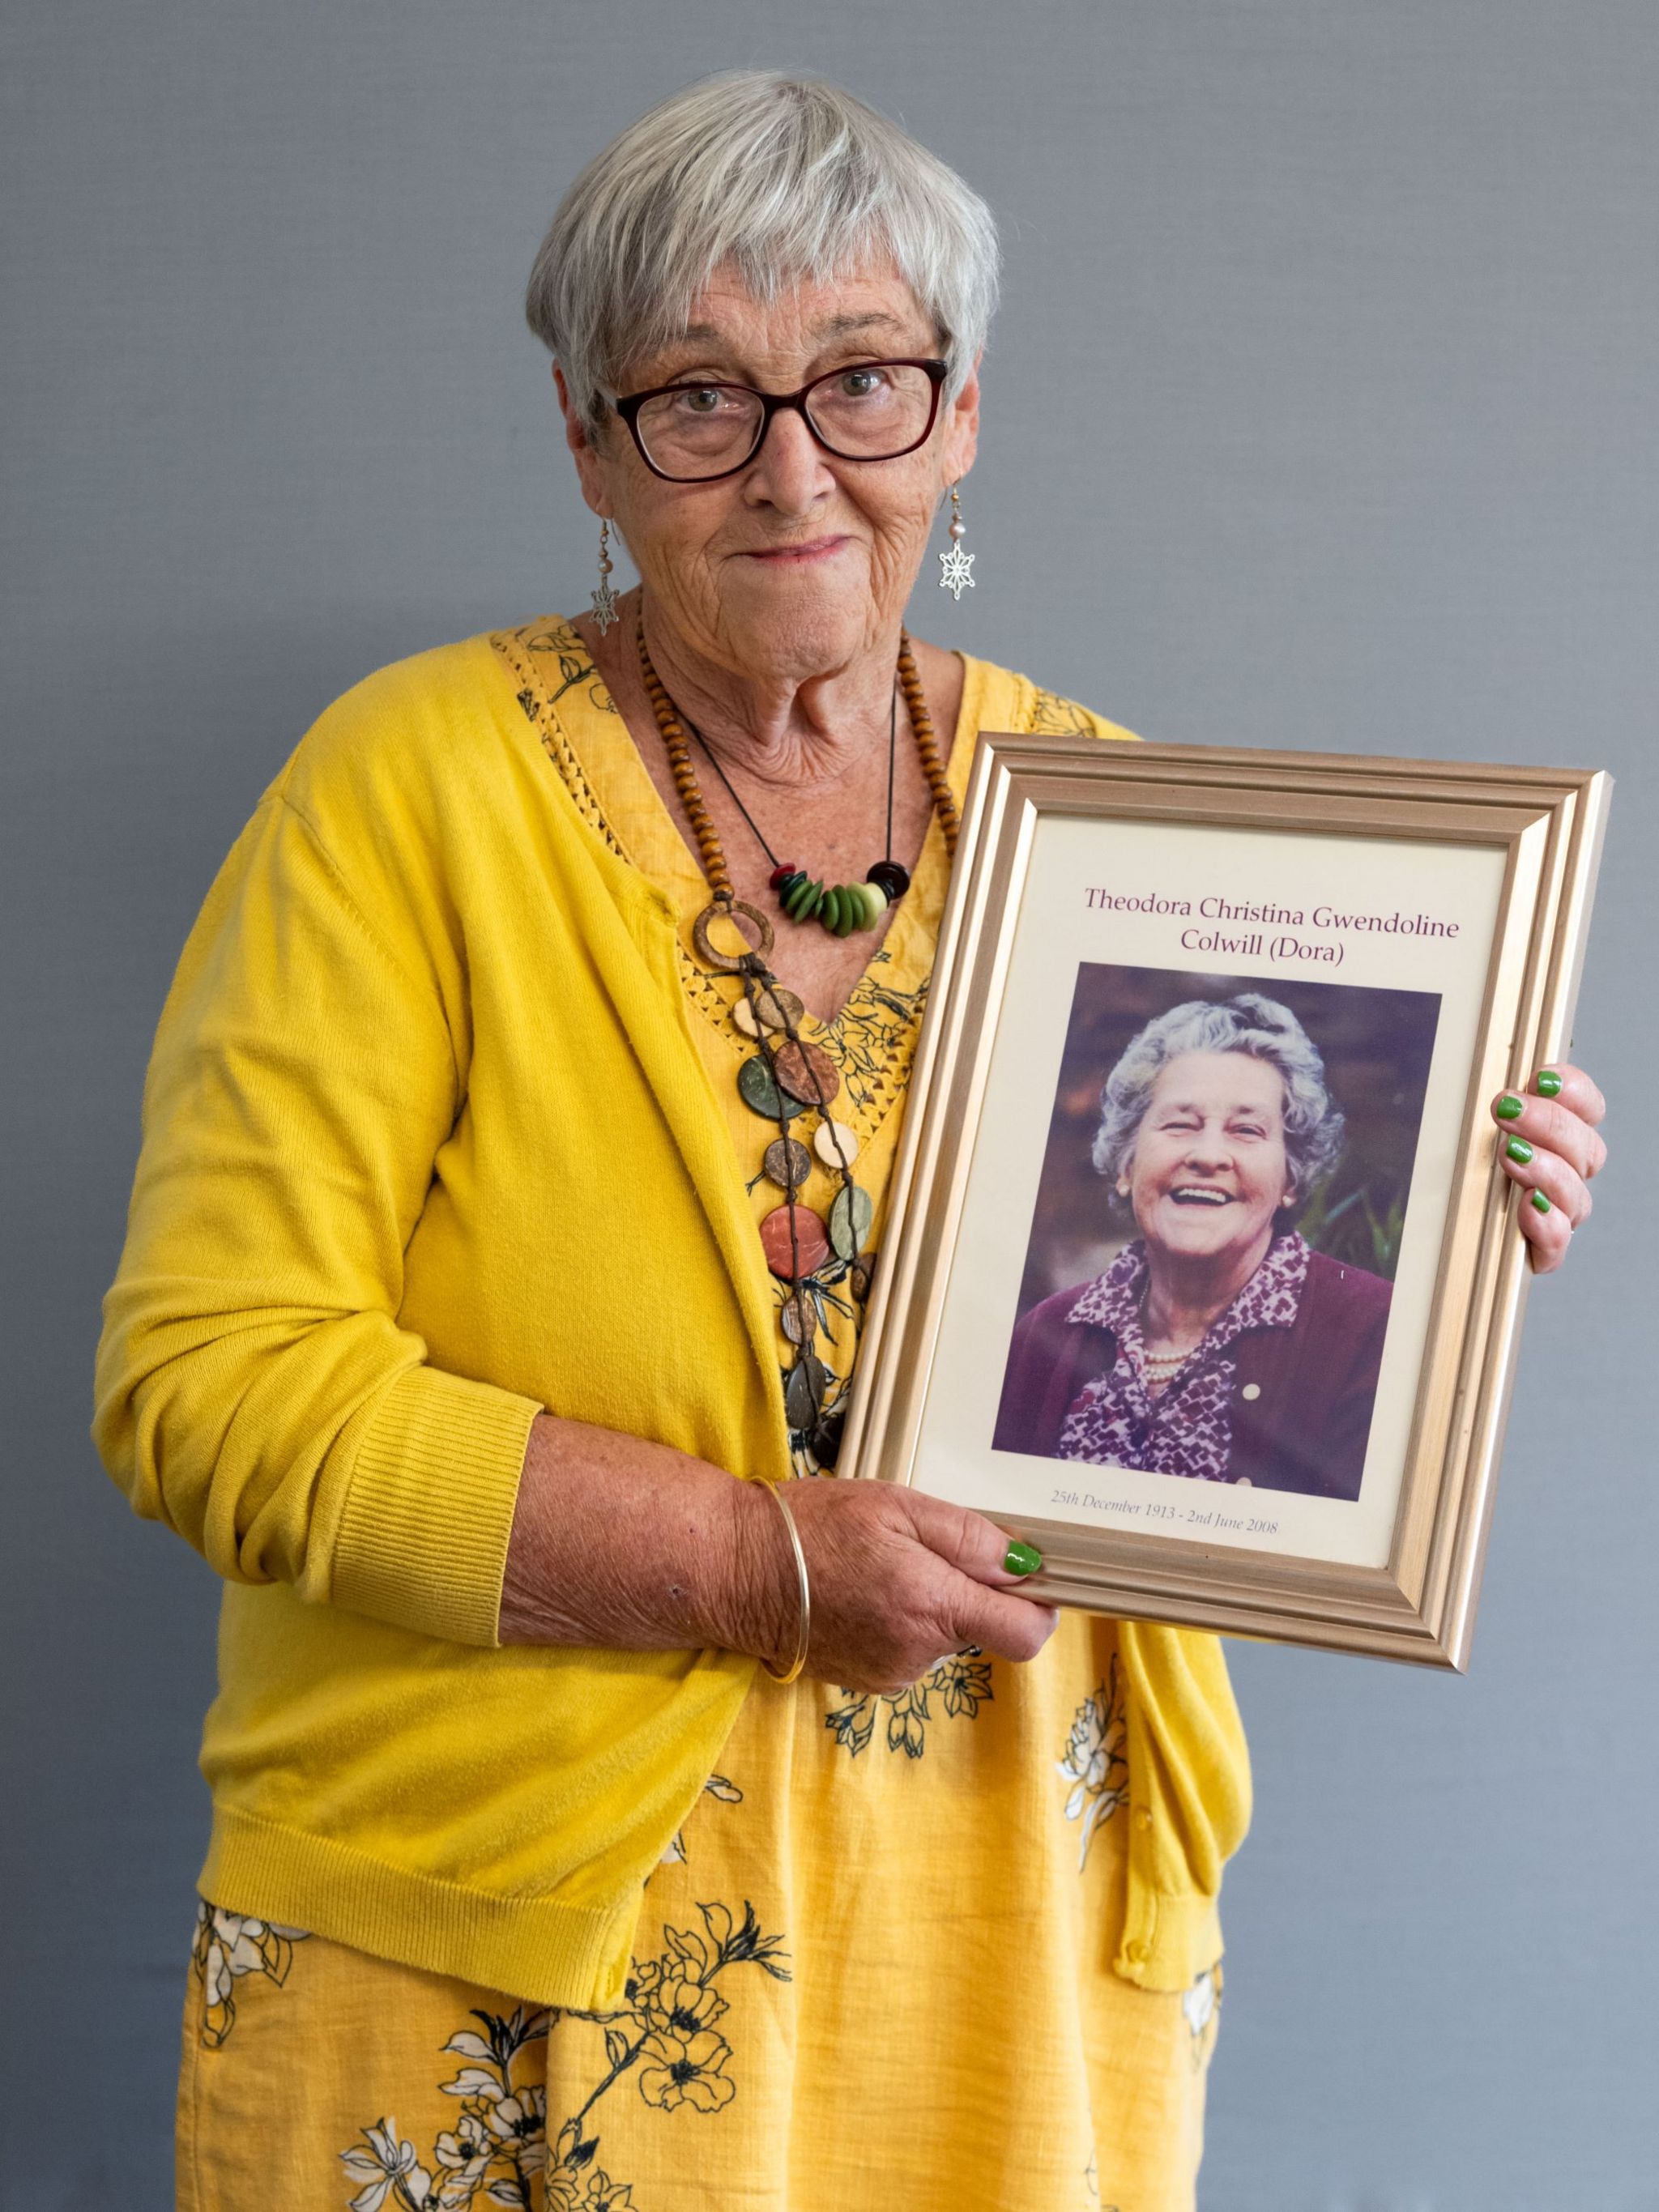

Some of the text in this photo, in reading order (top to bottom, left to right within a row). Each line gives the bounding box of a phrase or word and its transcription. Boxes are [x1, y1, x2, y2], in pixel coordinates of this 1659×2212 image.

[1085, 888, 1460, 939] Theodora Christina Gwendoline
[1180, 928, 1344, 967] Colwill (Dora)
[1051, 1490, 1079, 1506] 25th
[1081, 1494, 1141, 1514] December
[1145, 1503, 1175, 1519] 1913
[1187, 1509, 1212, 1525] 2nd
[1213, 1513, 1244, 1530] June
[1245, 1518, 1278, 1534] 2008
